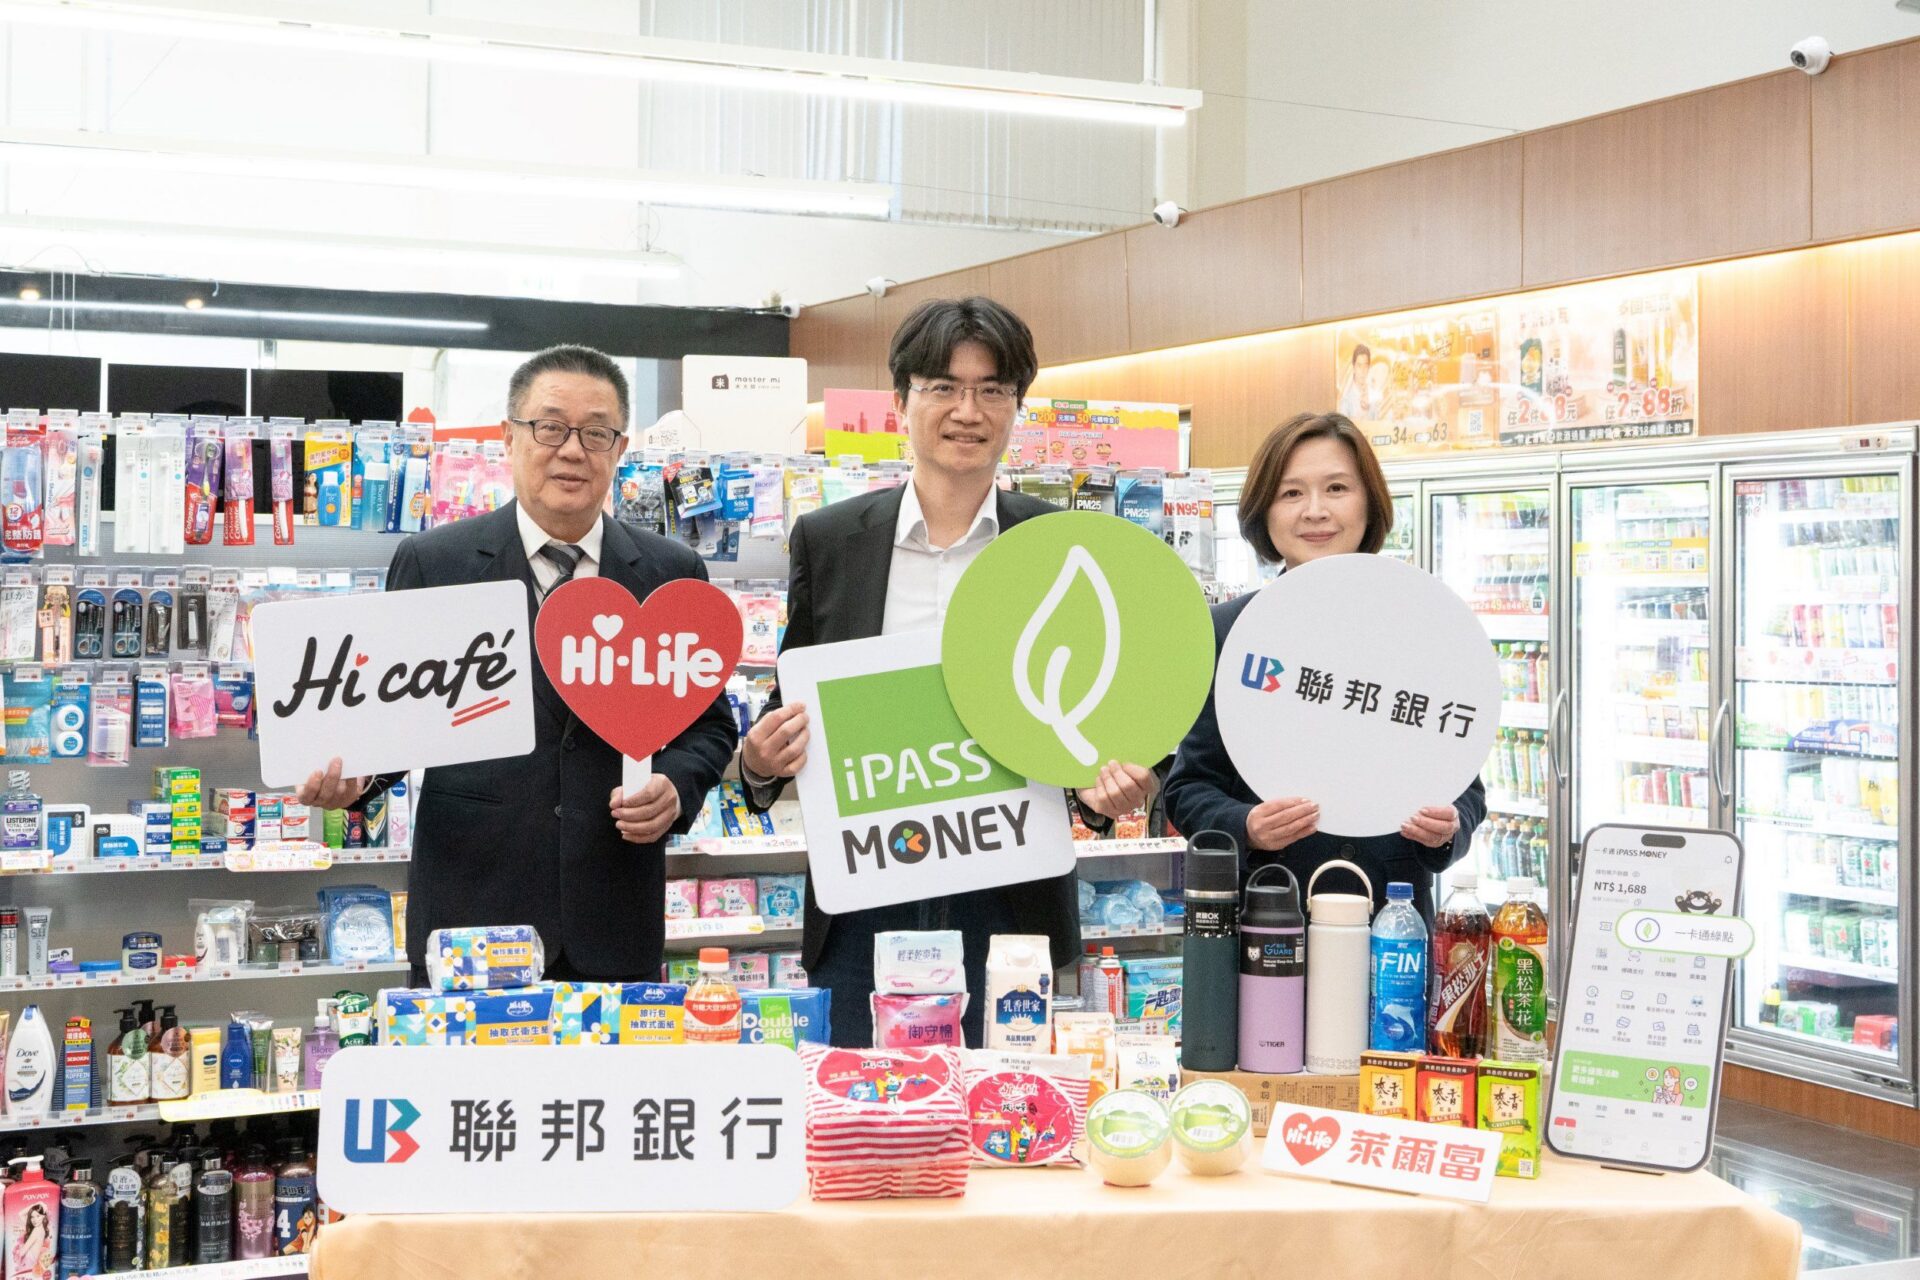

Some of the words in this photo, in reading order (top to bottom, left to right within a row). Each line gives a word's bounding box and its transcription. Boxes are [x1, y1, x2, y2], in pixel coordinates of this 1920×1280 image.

[1176, 503, 1198, 516] N95
[273, 634, 365, 717] Hi
[377, 629, 516, 708] café
[1295, 666, 1477, 738] 聯邦銀行
[843, 738, 993, 801] iPASS
[842, 800, 1030, 875] MONEY
[1594, 881, 1615, 892] NT$
[1618, 884, 1647, 895] 1,688
[1674, 928, 1734, 943] 一卡通綠點
[1381, 952, 1421, 973] FIN
[1516, 958, 1533, 1026] 黑松茶花
[640, 1008, 666, 1018] 旅行包
[1003, 999, 1040, 1012] 乳香世家
[630, 1020, 675, 1029] 抽取式面紙
[743, 1013, 809, 1028] Double
[750, 1026, 793, 1044] Care
[909, 1024, 953, 1040] 御守棉
[16, 1048, 39, 1057] Dove
[449, 1097, 783, 1163] 聯邦銀行
[1347, 1129, 1485, 1181] 萊爾富
[276, 1209, 291, 1237] 4
